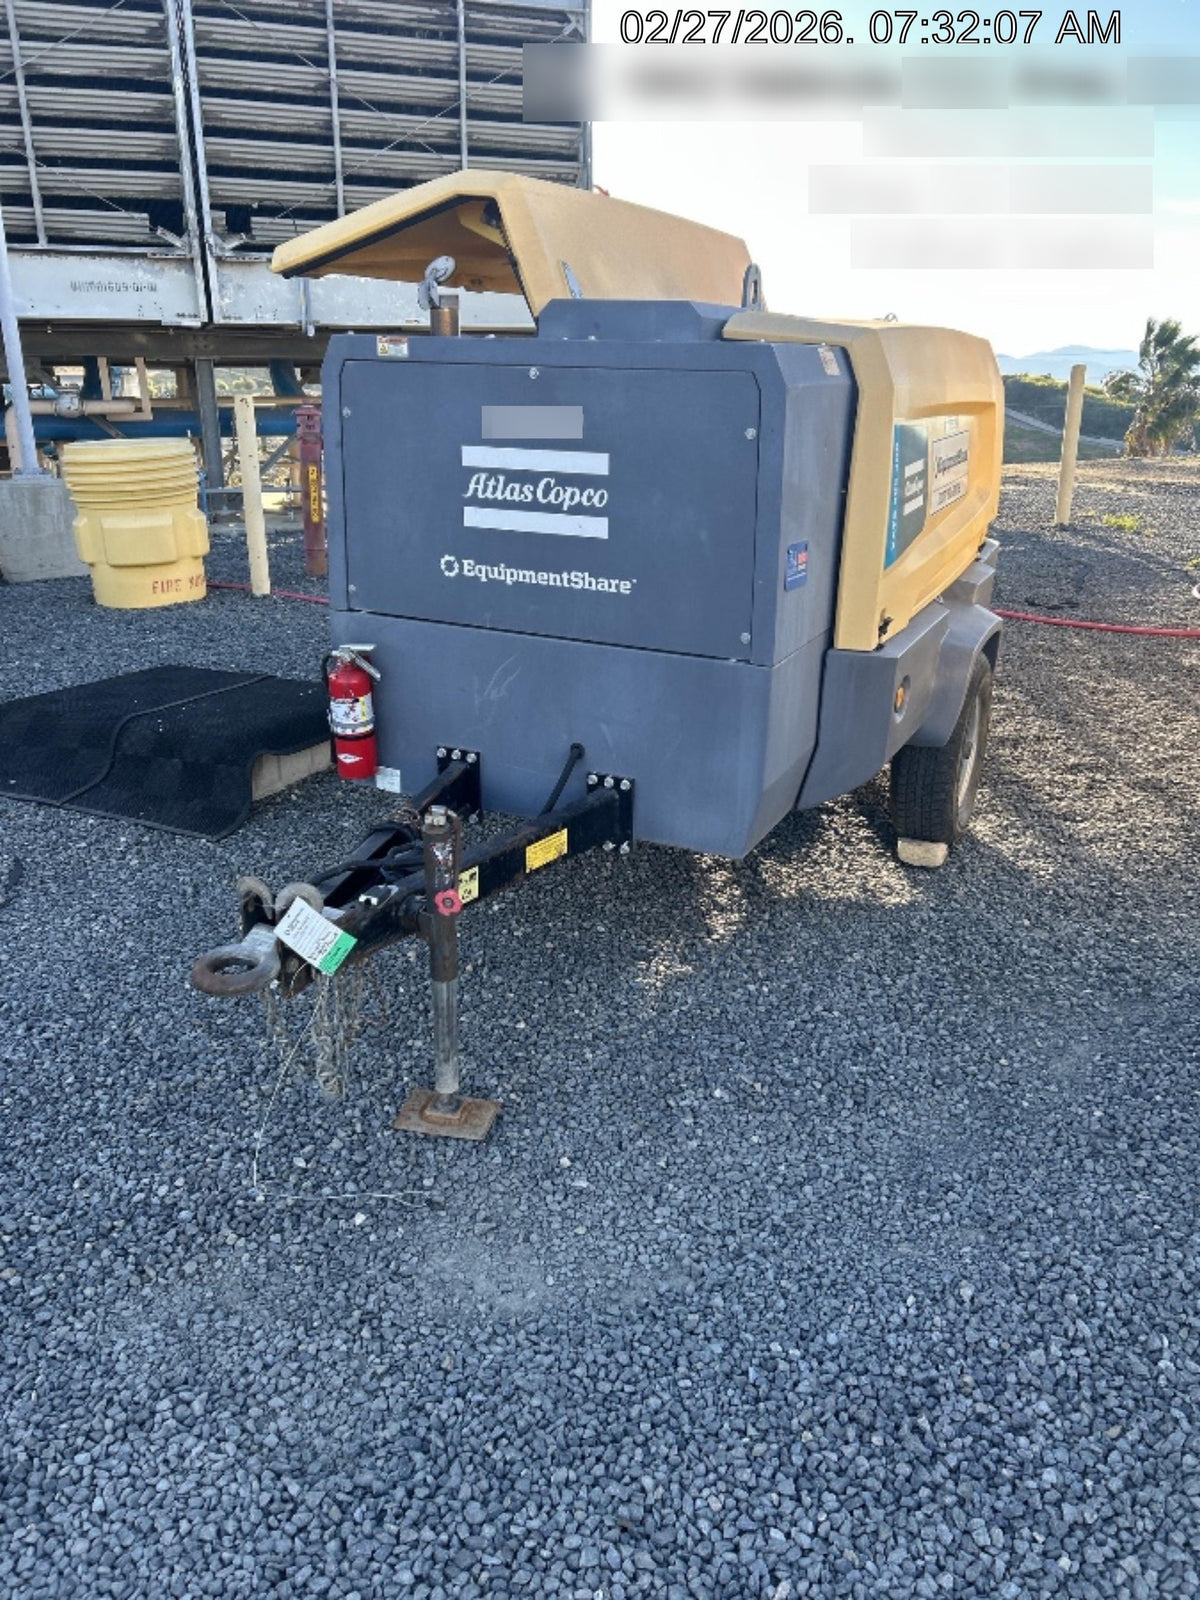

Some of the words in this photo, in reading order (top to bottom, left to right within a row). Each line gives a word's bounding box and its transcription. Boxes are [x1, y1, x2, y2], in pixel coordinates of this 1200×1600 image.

[462, 472, 534, 502] Atlas
[536, 477, 609, 512] Copco
[152, 578, 182, 594] FIRE
[461, 558, 632, 595] EquipmentShare
